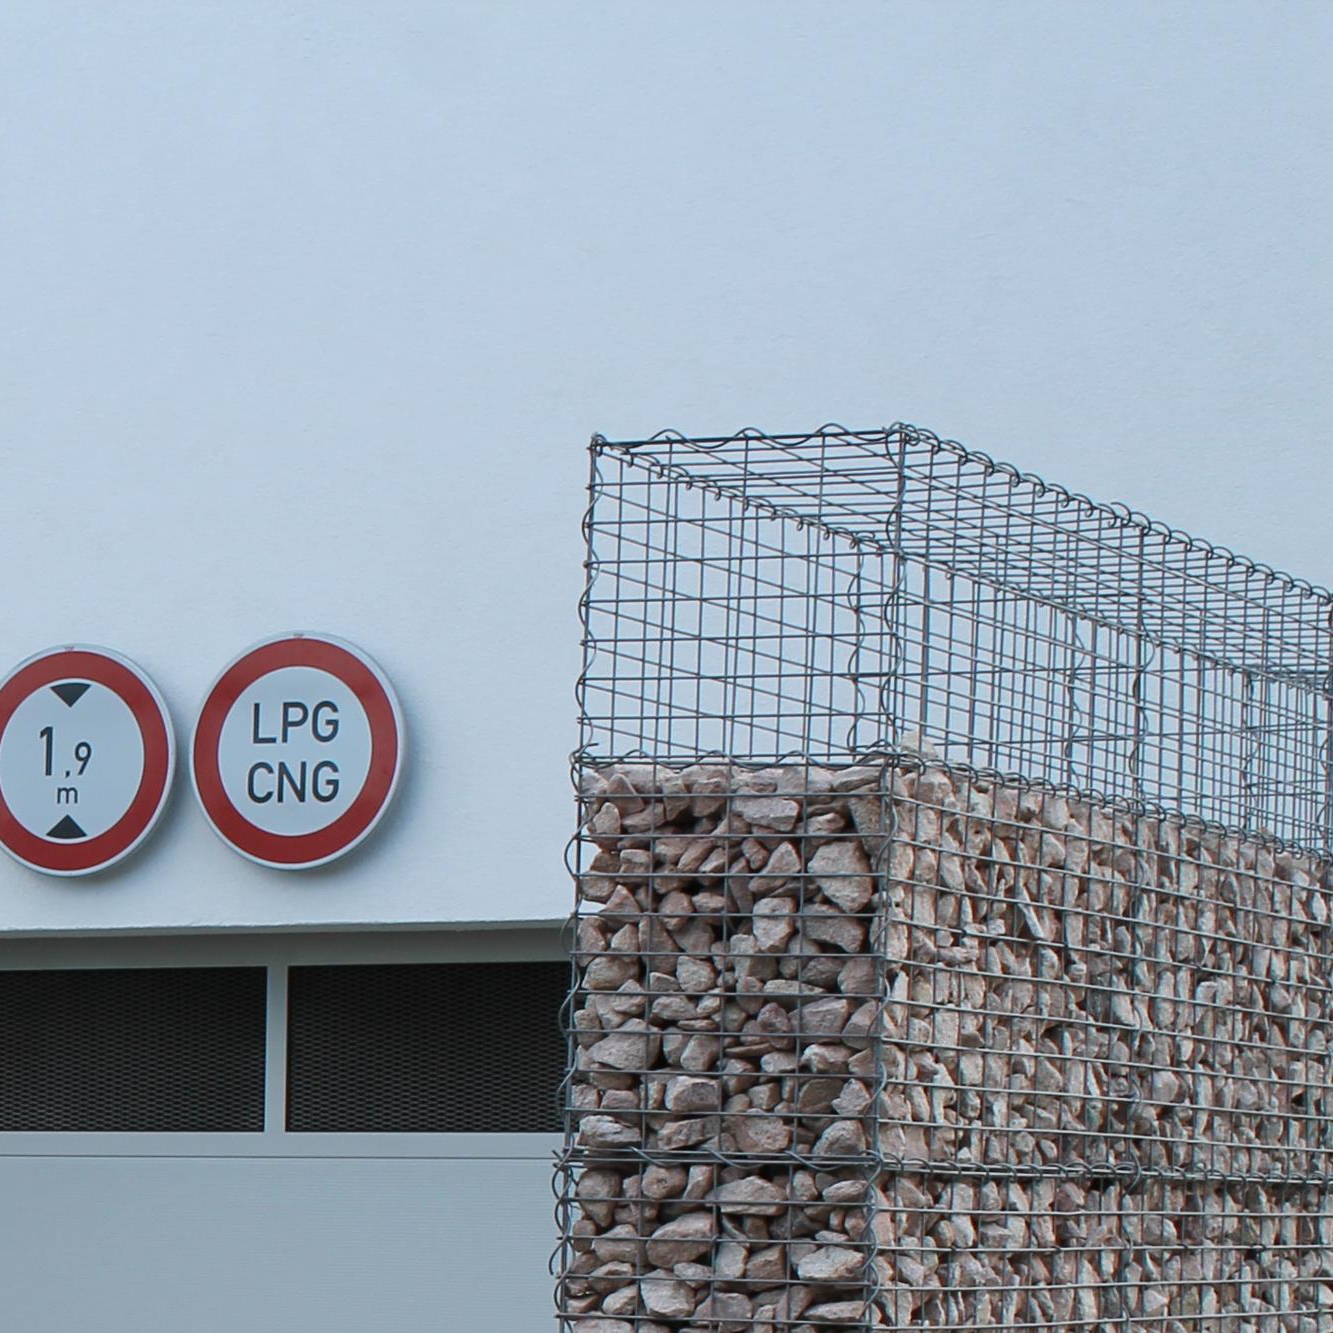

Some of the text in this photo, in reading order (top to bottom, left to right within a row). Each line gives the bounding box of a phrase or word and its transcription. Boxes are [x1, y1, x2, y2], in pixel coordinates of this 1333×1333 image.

[252, 700, 340, 745] LPG
[39, 725, 93, 779] 1,9
[56, 786, 79, 805] m
[247, 760, 340, 803] CNG
